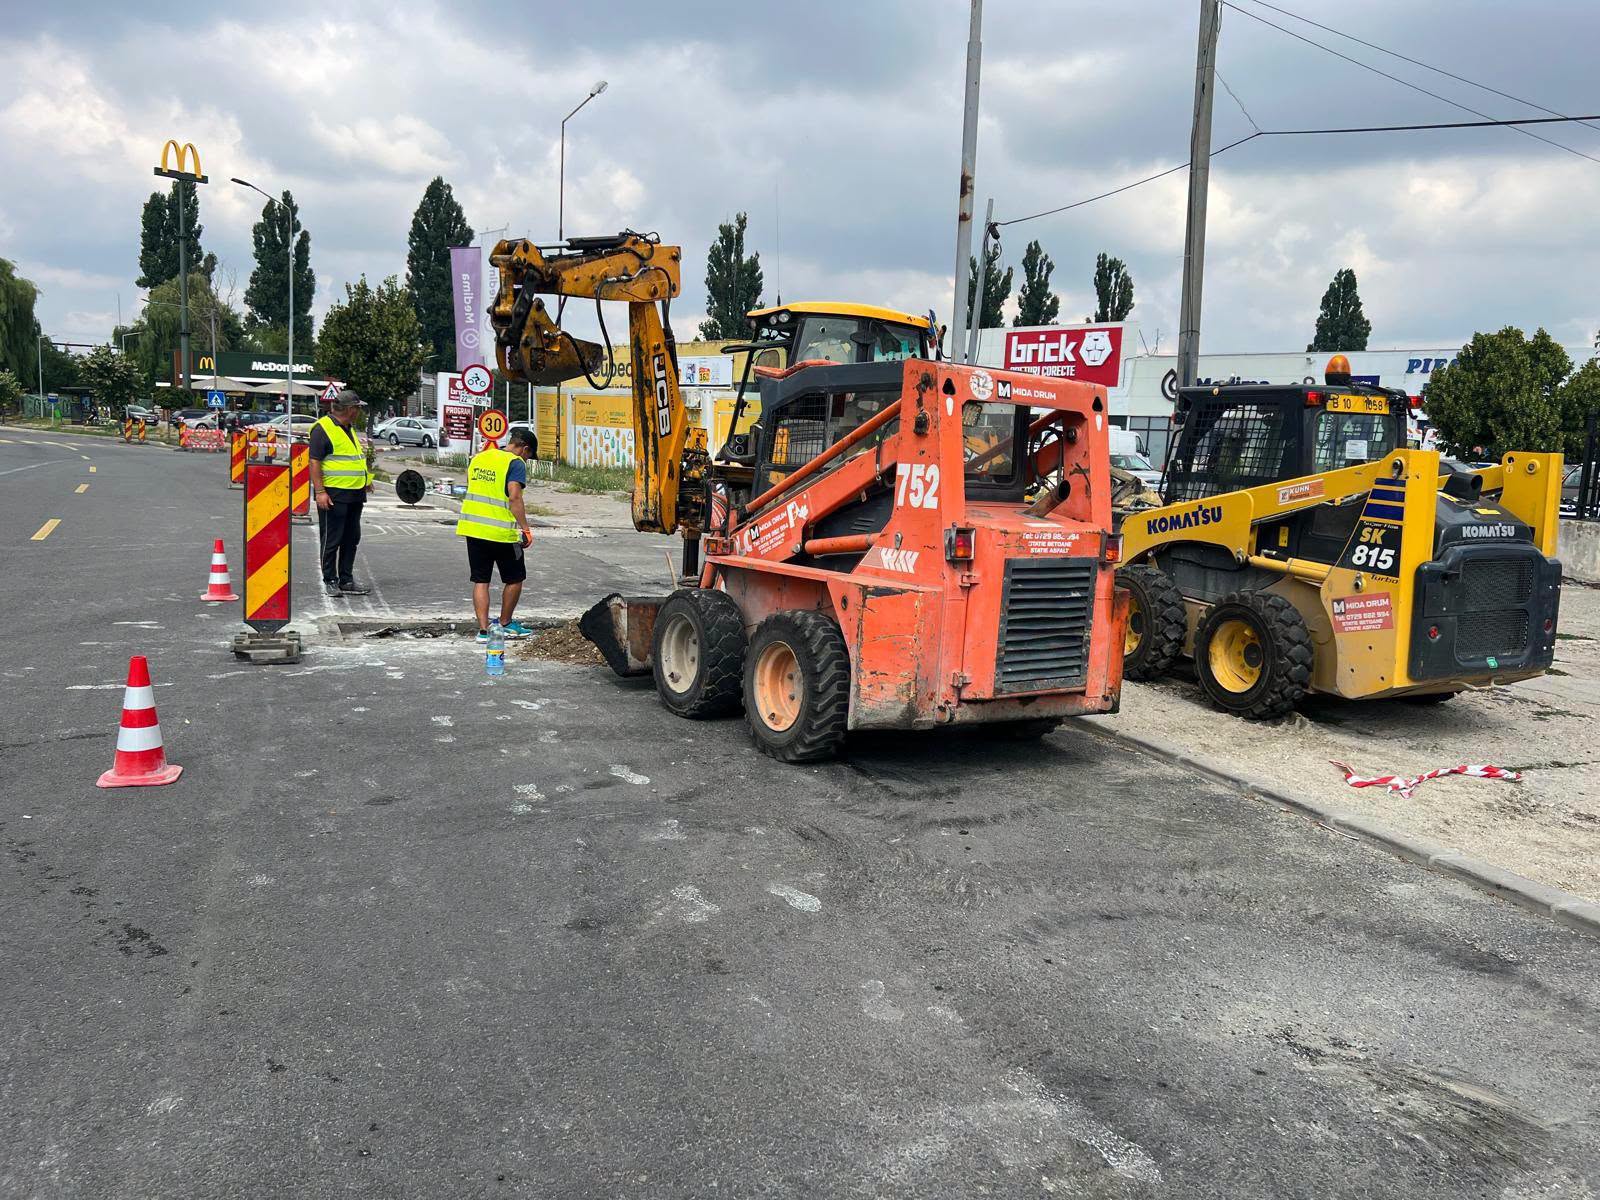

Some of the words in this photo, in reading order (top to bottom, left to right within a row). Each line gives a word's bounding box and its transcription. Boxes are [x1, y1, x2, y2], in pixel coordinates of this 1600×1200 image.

[1010, 334, 1077, 363] brick
[1041, 365, 1076, 377] CORECTE
[654, 356, 671, 436] JCB
[1013, 388, 1031, 397] MIDA
[1033, 390, 1057, 400] DRUM
[1343, 398, 1352, 410] 10
[485, 417, 502, 432] 30
[478, 474, 496, 482] DRUM
[480, 469, 496, 477] MIDA
[896, 463, 940, 509] 752
[1290, 484, 1310, 494] KUHN
[1147, 504, 1222, 535] KOMATSU
[1360, 527, 1386, 544] SK
[1462, 523, 1515, 537] KOMATSU
[1352, 545, 1395, 570] 815
[1370, 574, 1399, 585] Turbo
[1346, 600, 1365, 610] MIDA
[1366, 598, 1389, 608] DRUM
